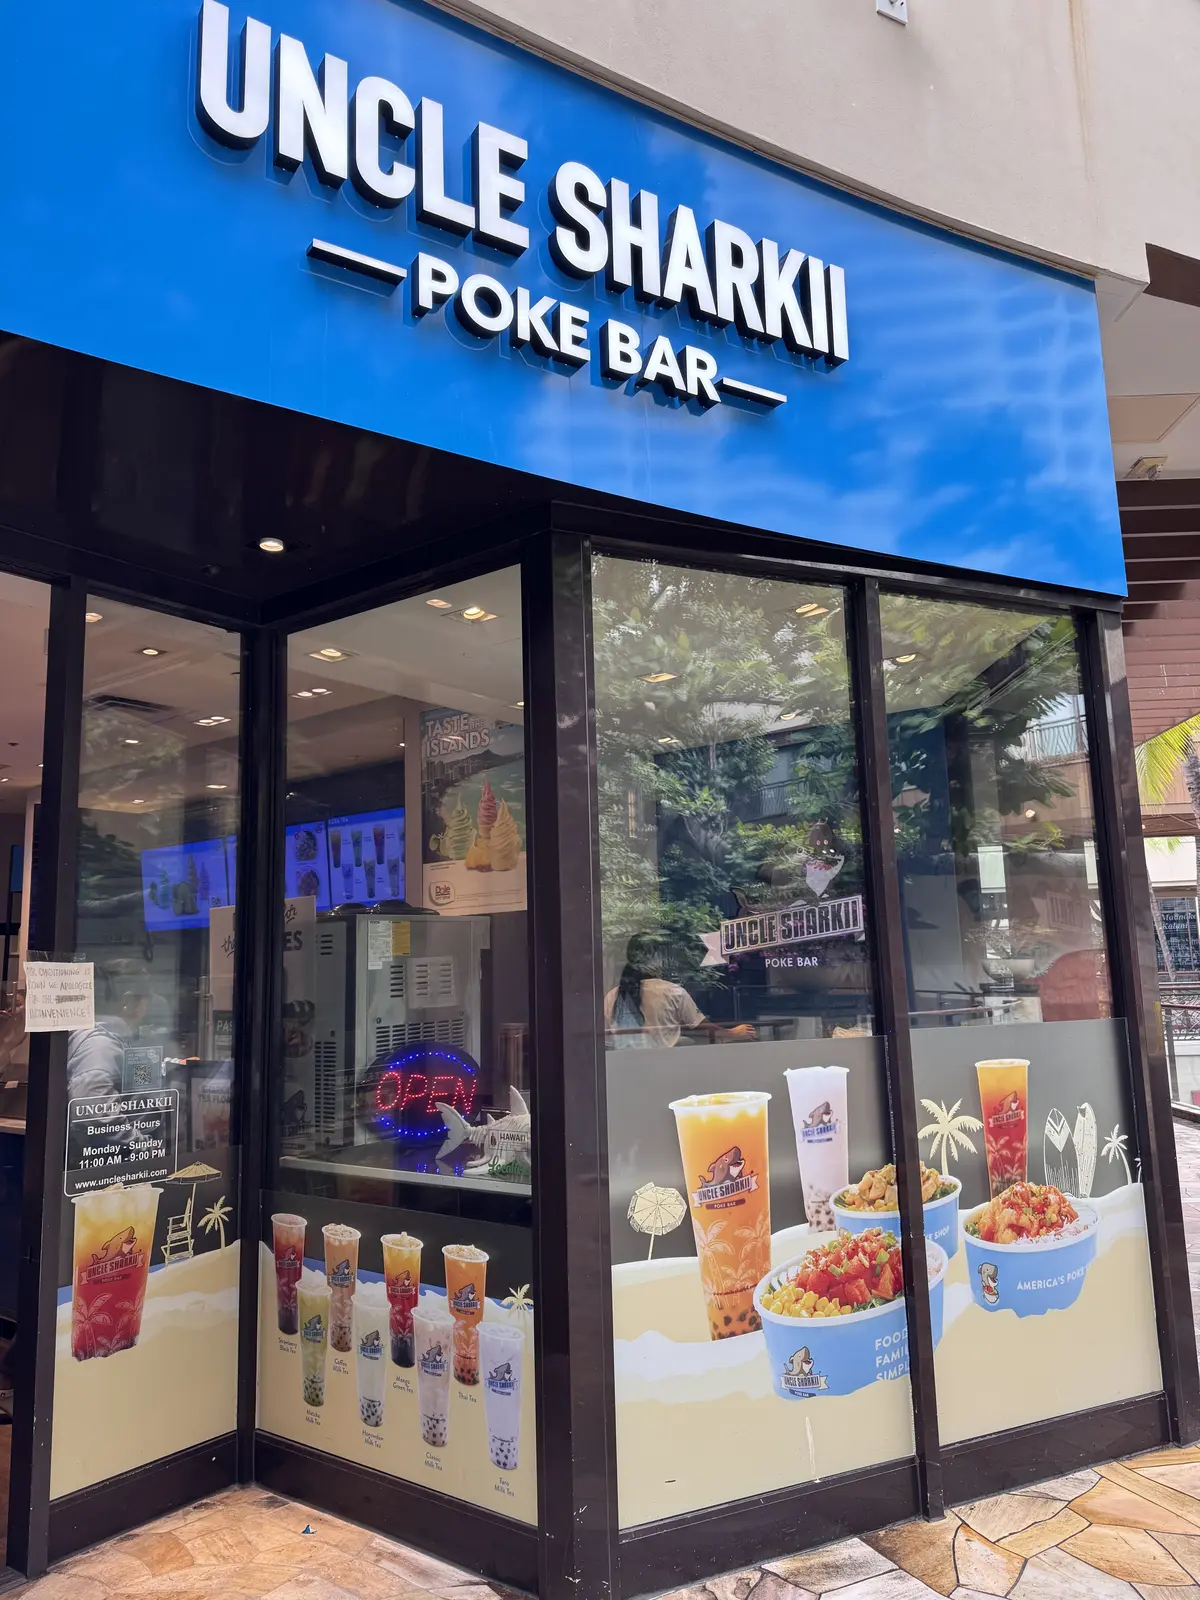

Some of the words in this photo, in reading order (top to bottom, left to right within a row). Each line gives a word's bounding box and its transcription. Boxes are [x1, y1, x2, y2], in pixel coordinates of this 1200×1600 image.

[197, 0, 530, 256] UNCLE
[550, 161, 849, 364] SHARKII
[414, 252, 591, 363] POKE
[603, 320, 720, 405] BAR
[425, 713, 469, 737] TASTE
[425, 728, 490, 757] ISLANDS
[724, 913, 778, 950] UNCLE
[780, 900, 859, 941] SHARKII
[765, 957, 793, 968] POKE
[797, 956, 819, 967] BAR
[375, 1071, 478, 1115] OPEN
[75, 1102, 119, 1117] UNCLE
[120, 1096, 173, 1113] SHARKII
[87, 1122, 131, 1136] Business
[133, 1119, 161, 1131] Hours
[82, 1144, 121, 1157] Monday
[129, 1138, 163, 1151] Sunday
[78, 1157, 104, 1169] 11:00
[106, 1155, 122, 1165] AM
[129, 1151, 149, 1162] 9:00
[151, 1149, 166, 1159] PM
[74, 1168, 168, 1190] www.unclesharkii.com
[697, 1187, 718, 1202] UNCLE
[1016, 1275, 1066, 1291] AMERICA'S
[1066, 1266, 1086, 1283] POKE
[392, 1382, 406, 1391] Green
[406, 1385, 414, 1393] Tea
[458, 1391, 468, 1401] Thai
[468, 1394, 477, 1403] Tea
[424, 1459, 434, 1468] Milk
[435, 1462, 443, 1471] Tea
[425, 1451, 441, 1462] Classic
[494, 1484, 505, 1493] Milk
[505, 1487, 515, 1497] Tea
[499, 1476, 510, 1486] Taro
